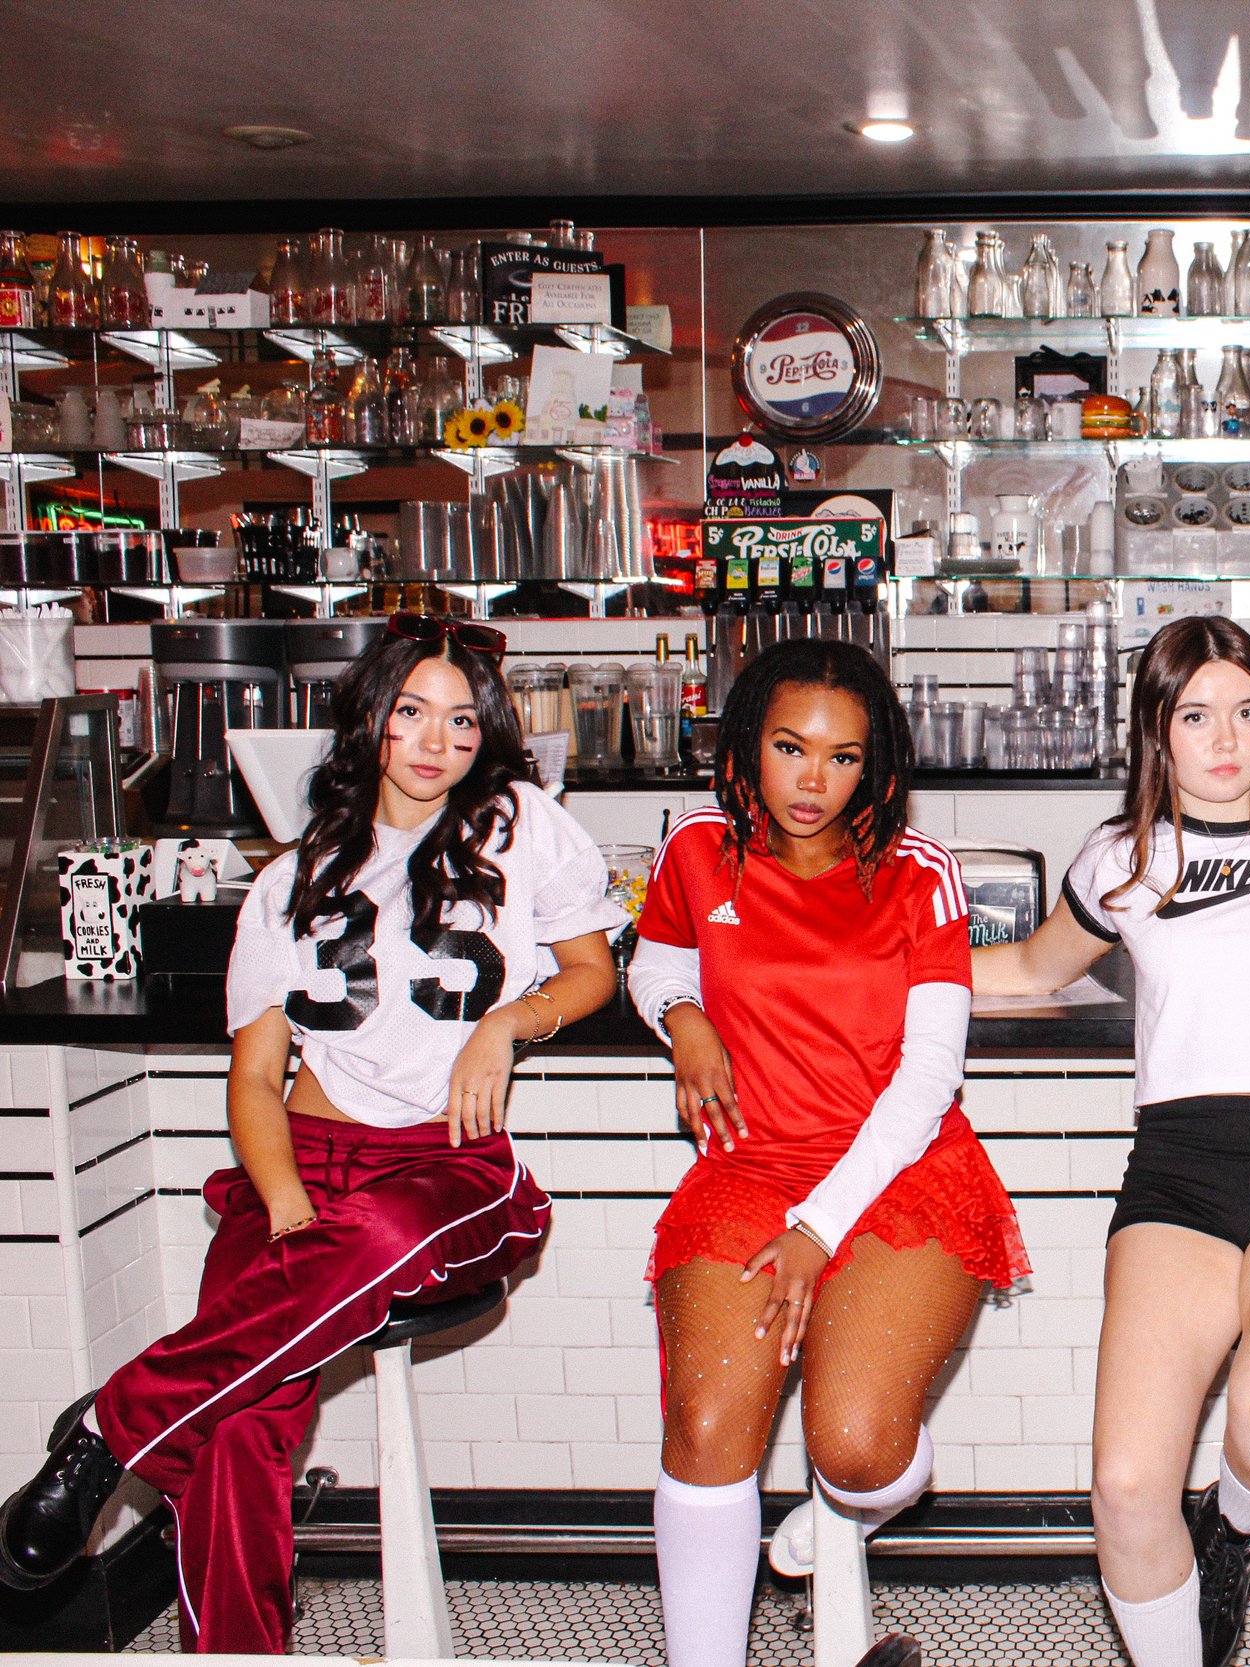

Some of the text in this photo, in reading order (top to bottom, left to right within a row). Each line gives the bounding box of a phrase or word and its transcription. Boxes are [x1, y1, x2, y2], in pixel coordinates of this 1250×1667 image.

[491, 251, 530, 267] ENTER
[533, 253, 550, 267] AS
[802, 401, 810, 412] 6
[741, 472, 780, 491] VANILLA
[705, 505, 729, 516] CHP
[75, 878, 106, 890] FRESH
[707, 913, 741, 926] adidas
[970, 913, 989, 925] The
[77, 925, 110, 937] COOKIES
[80, 945, 107, 956] MILK
[285, 870, 507, 1031] 35
